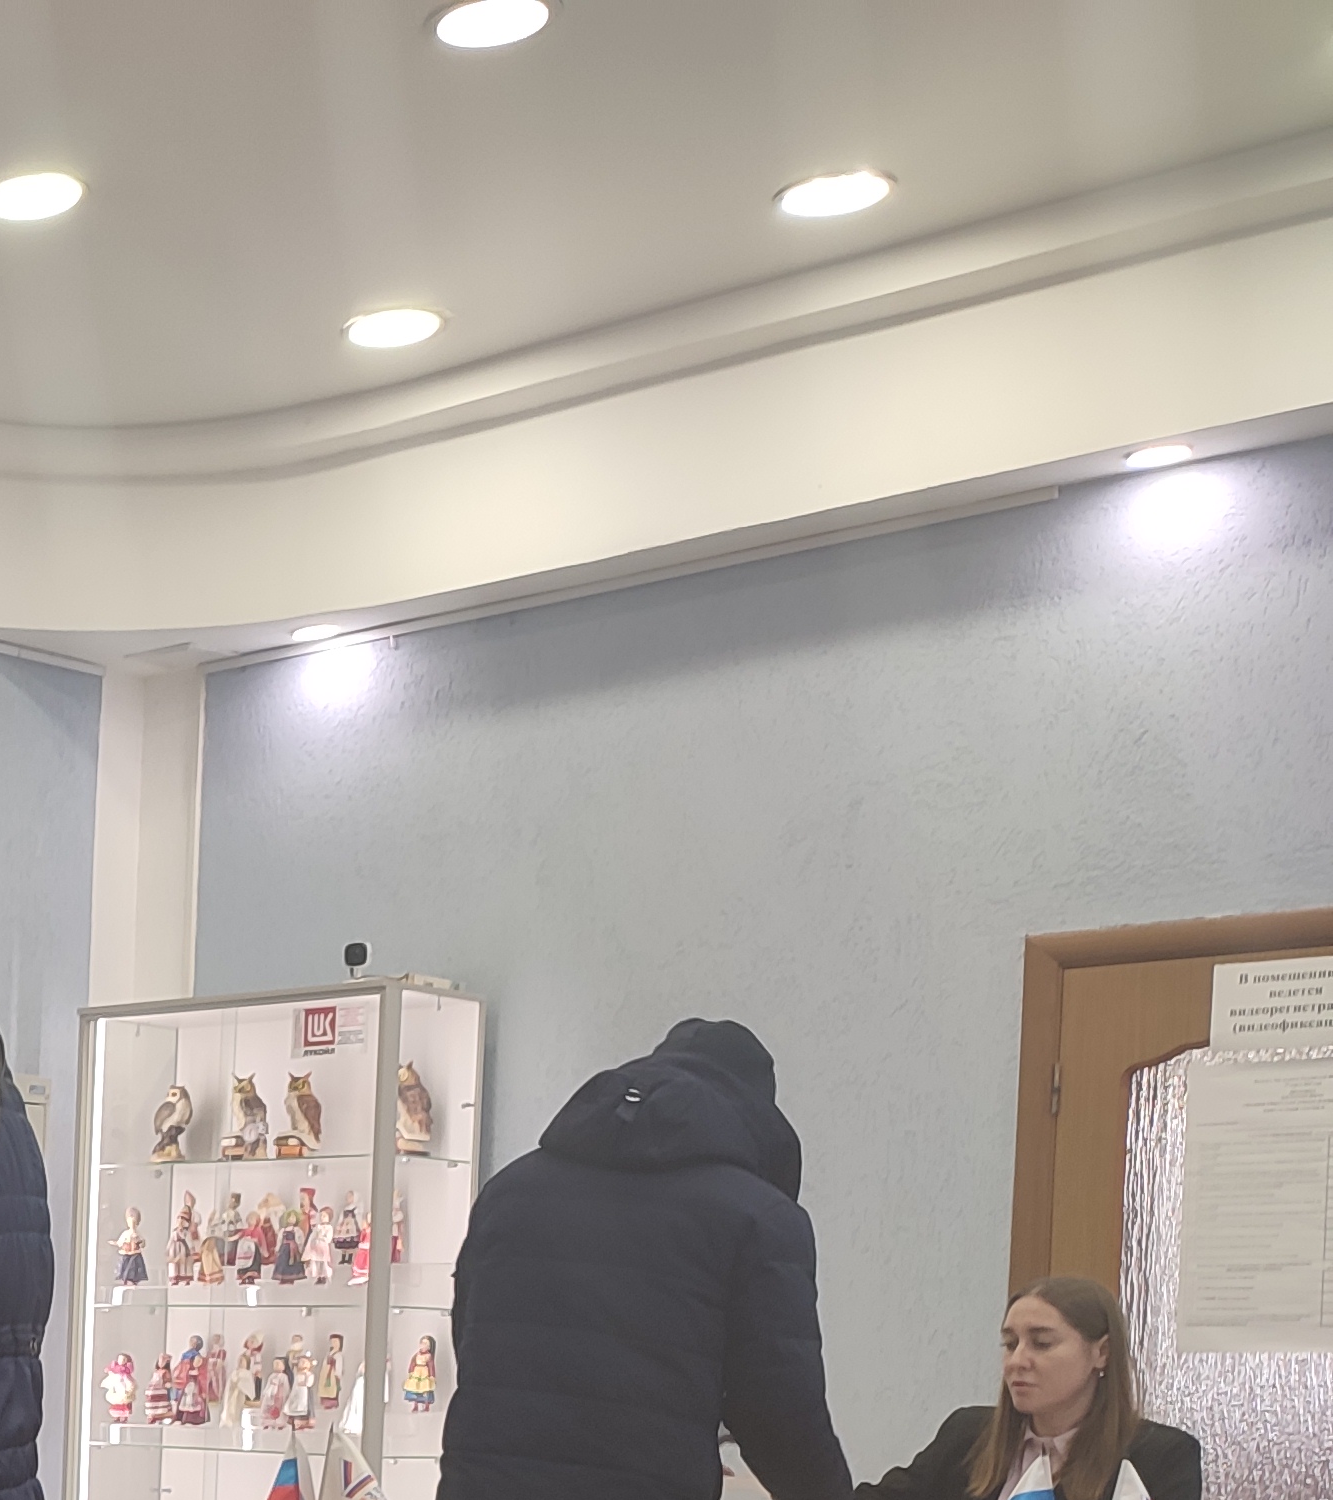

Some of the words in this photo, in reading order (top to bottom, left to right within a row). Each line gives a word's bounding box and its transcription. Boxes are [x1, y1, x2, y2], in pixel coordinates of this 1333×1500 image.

[1239, 973, 1249, 985] В
[1229, 1003, 1333, 1017] видеорегистра
[1233, 1019, 1333, 1034] (видеофиксац
